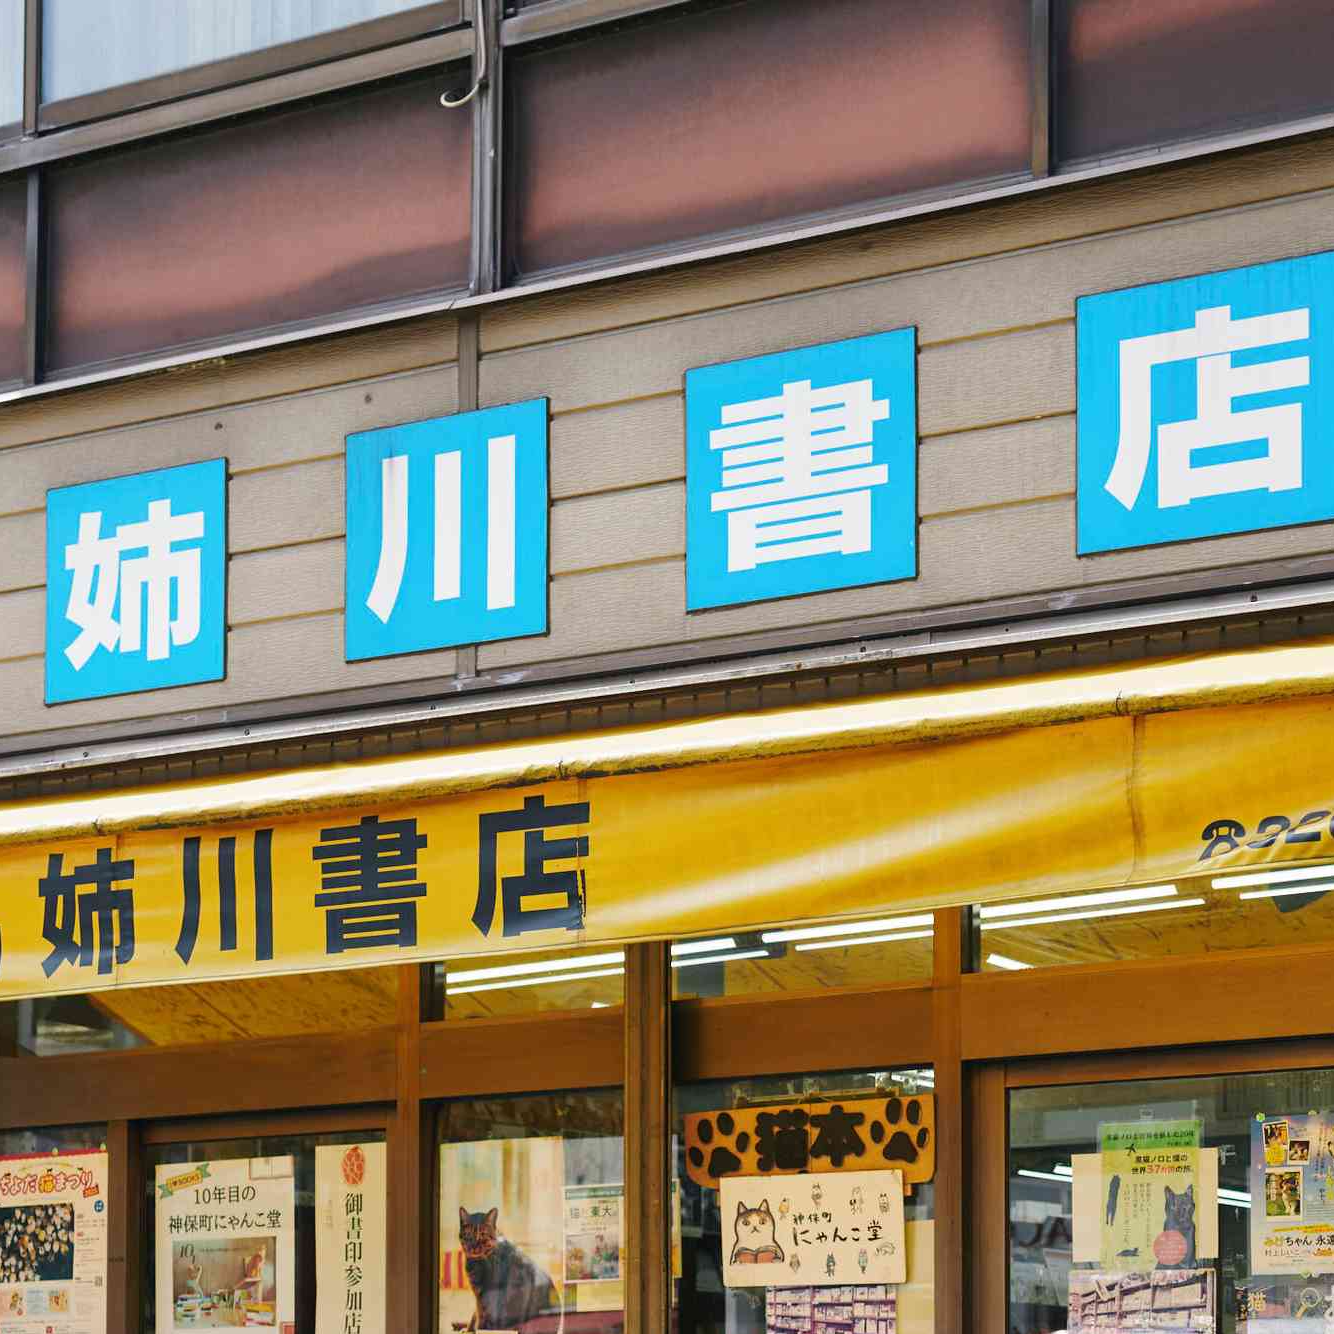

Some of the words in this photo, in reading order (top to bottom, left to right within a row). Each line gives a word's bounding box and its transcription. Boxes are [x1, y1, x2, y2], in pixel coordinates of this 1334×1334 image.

[38, 795, 590, 978] 姉川書店
[755, 1105, 865, 1168] 猫本
[194, 1185, 256, 1206] 10年目の
[169, 1209, 282, 1235] 神保町にゃんこ堂
[793, 1211, 832, 1225] 神保町
[792, 1219, 883, 1246] にゃんこ堂
